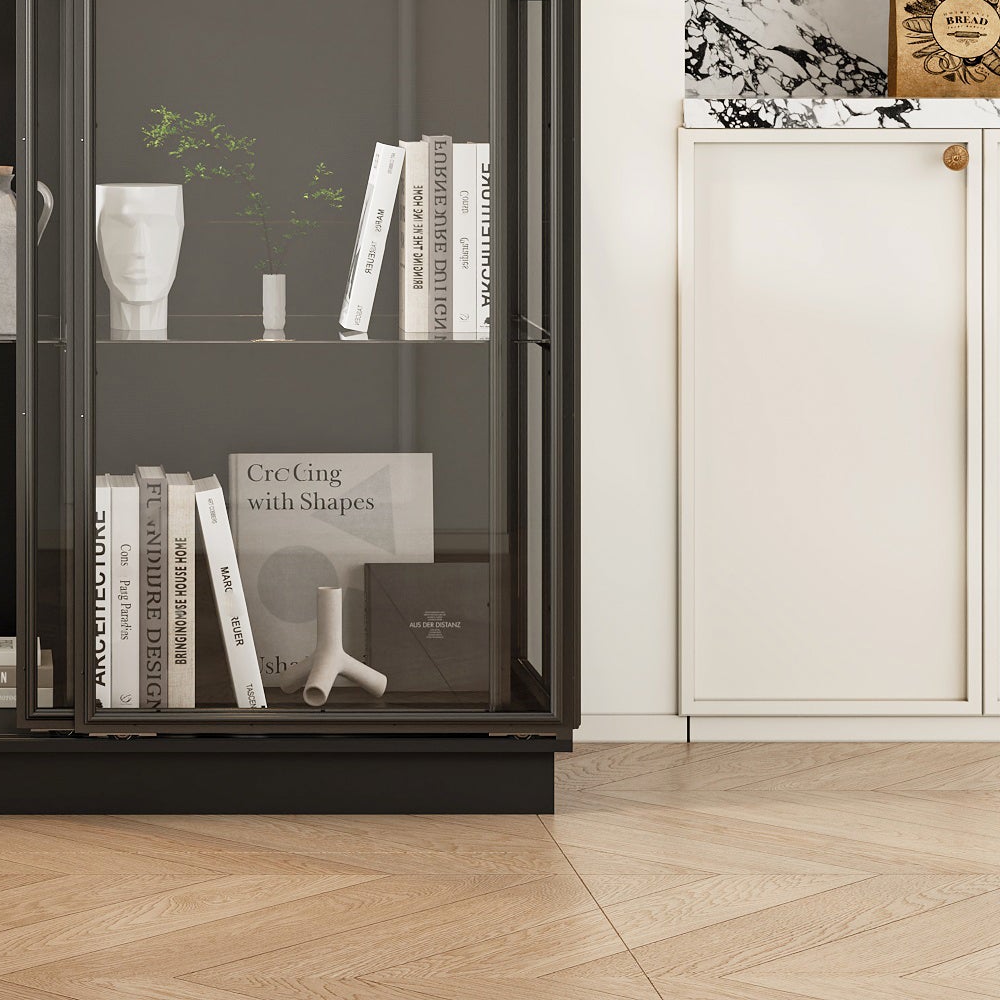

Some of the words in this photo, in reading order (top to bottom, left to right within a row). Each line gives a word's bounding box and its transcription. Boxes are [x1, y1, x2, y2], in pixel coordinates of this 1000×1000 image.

[946, 15, 989, 26] BREAD
[247, 492, 294, 512] with
[300, 492, 375, 516] Shapes
[174, 538, 187, 563] HOME
[174, 566, 187, 597] HOUSE
